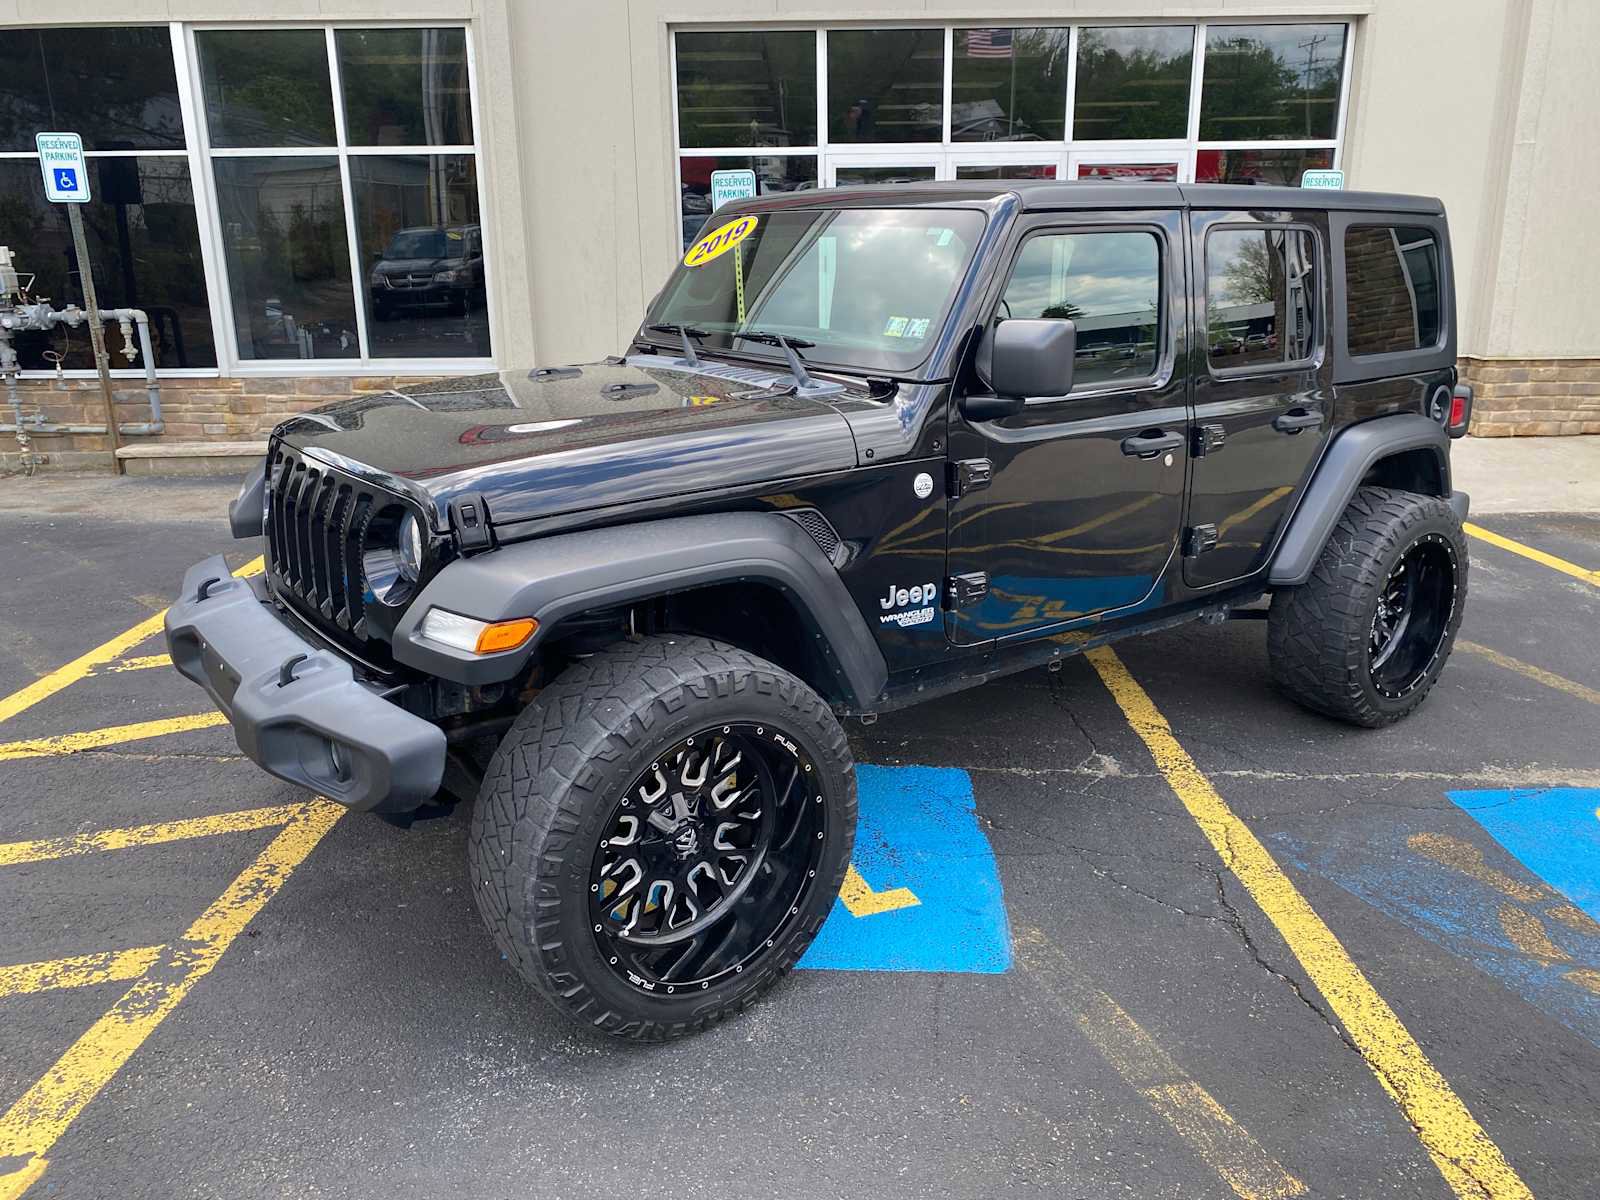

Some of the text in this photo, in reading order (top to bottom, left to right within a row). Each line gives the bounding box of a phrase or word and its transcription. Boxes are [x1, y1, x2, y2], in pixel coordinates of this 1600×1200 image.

[41, 140, 79, 150] RESERVED
[45, 152, 78, 160] PARKING
[715, 177, 752, 187] RESERVED
[1305, 177, 1341, 187] RESERVED
[719, 189, 750, 198] PARKING
[691, 220, 749, 263] 2019
[880, 583, 937, 610] Jeep
[880, 607, 935, 624] WRANGLER
[774, 733, 799, 758] FUEL
[626, 969, 656, 992] FUEL
